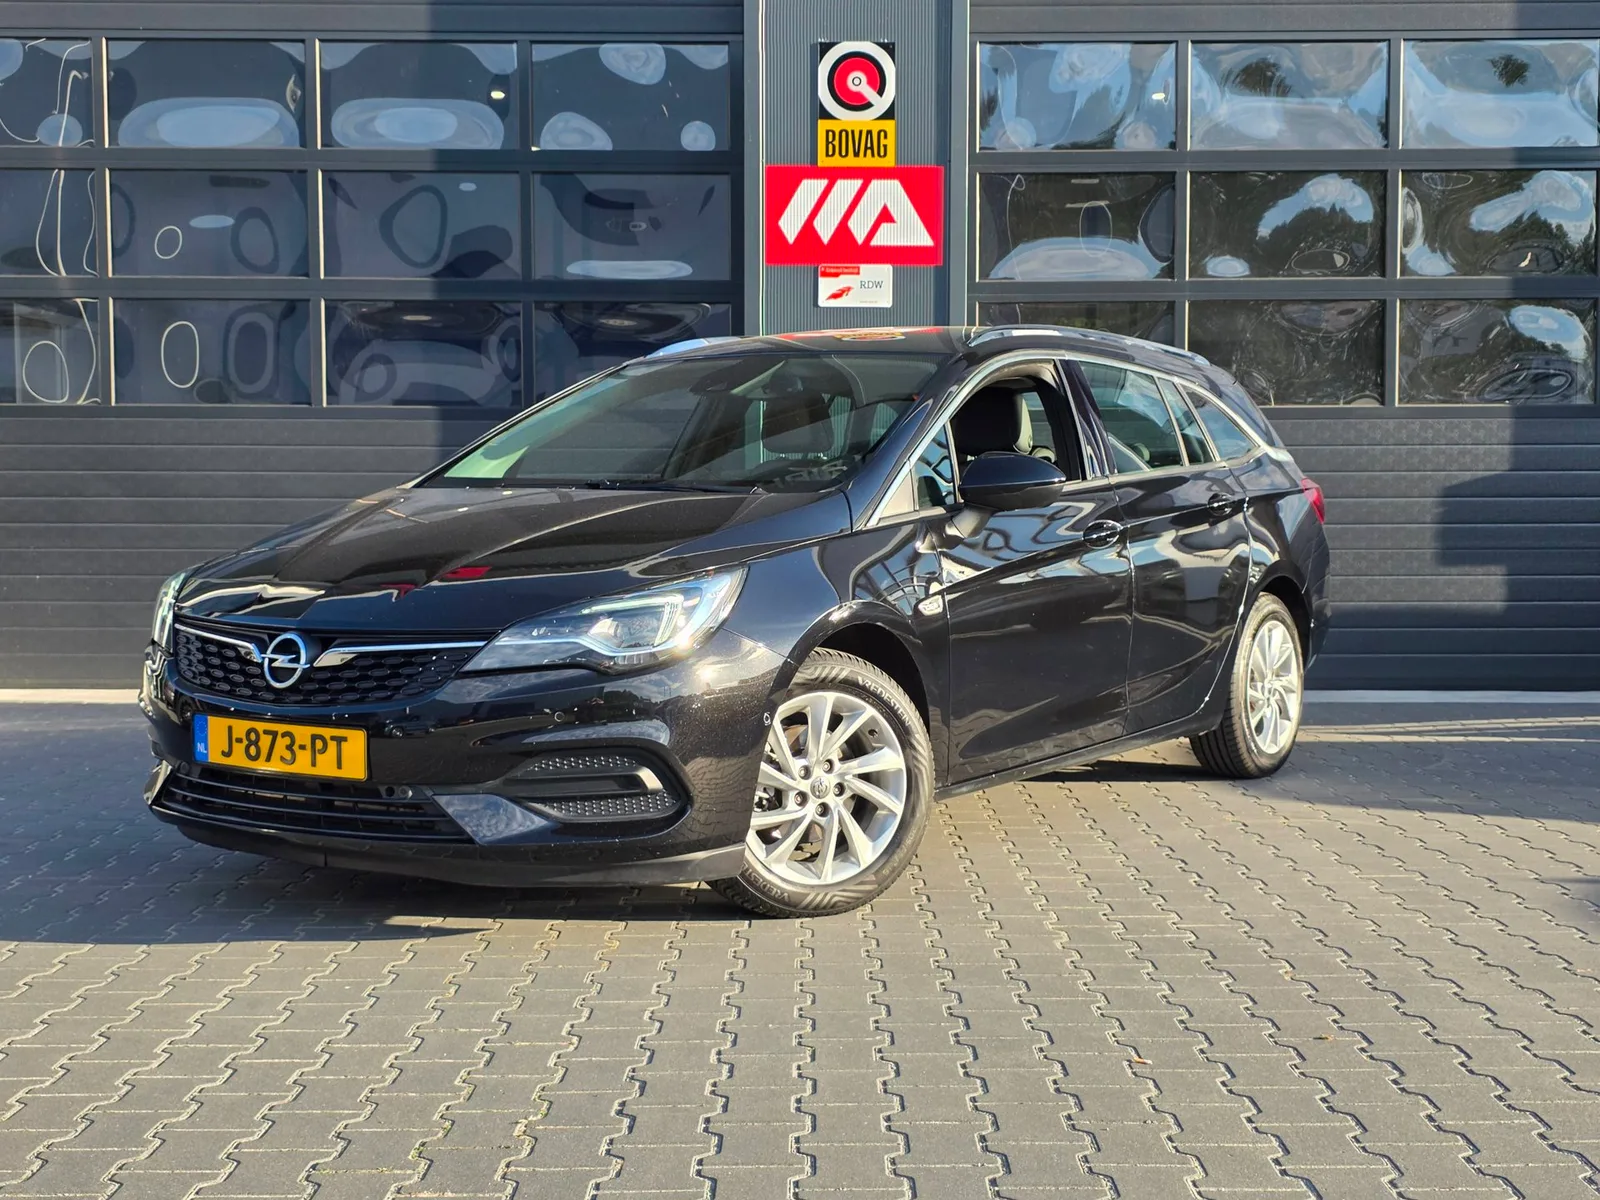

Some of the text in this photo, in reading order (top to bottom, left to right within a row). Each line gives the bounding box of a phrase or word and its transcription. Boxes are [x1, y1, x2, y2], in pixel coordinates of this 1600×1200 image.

[825, 128, 888, 159] BOVAG
[859, 280, 884, 289] RDW
[857, 676, 911, 727] VREDESTEIN
[197, 742, 208, 754] NL
[221, 724, 348, 770] J-873-PT
